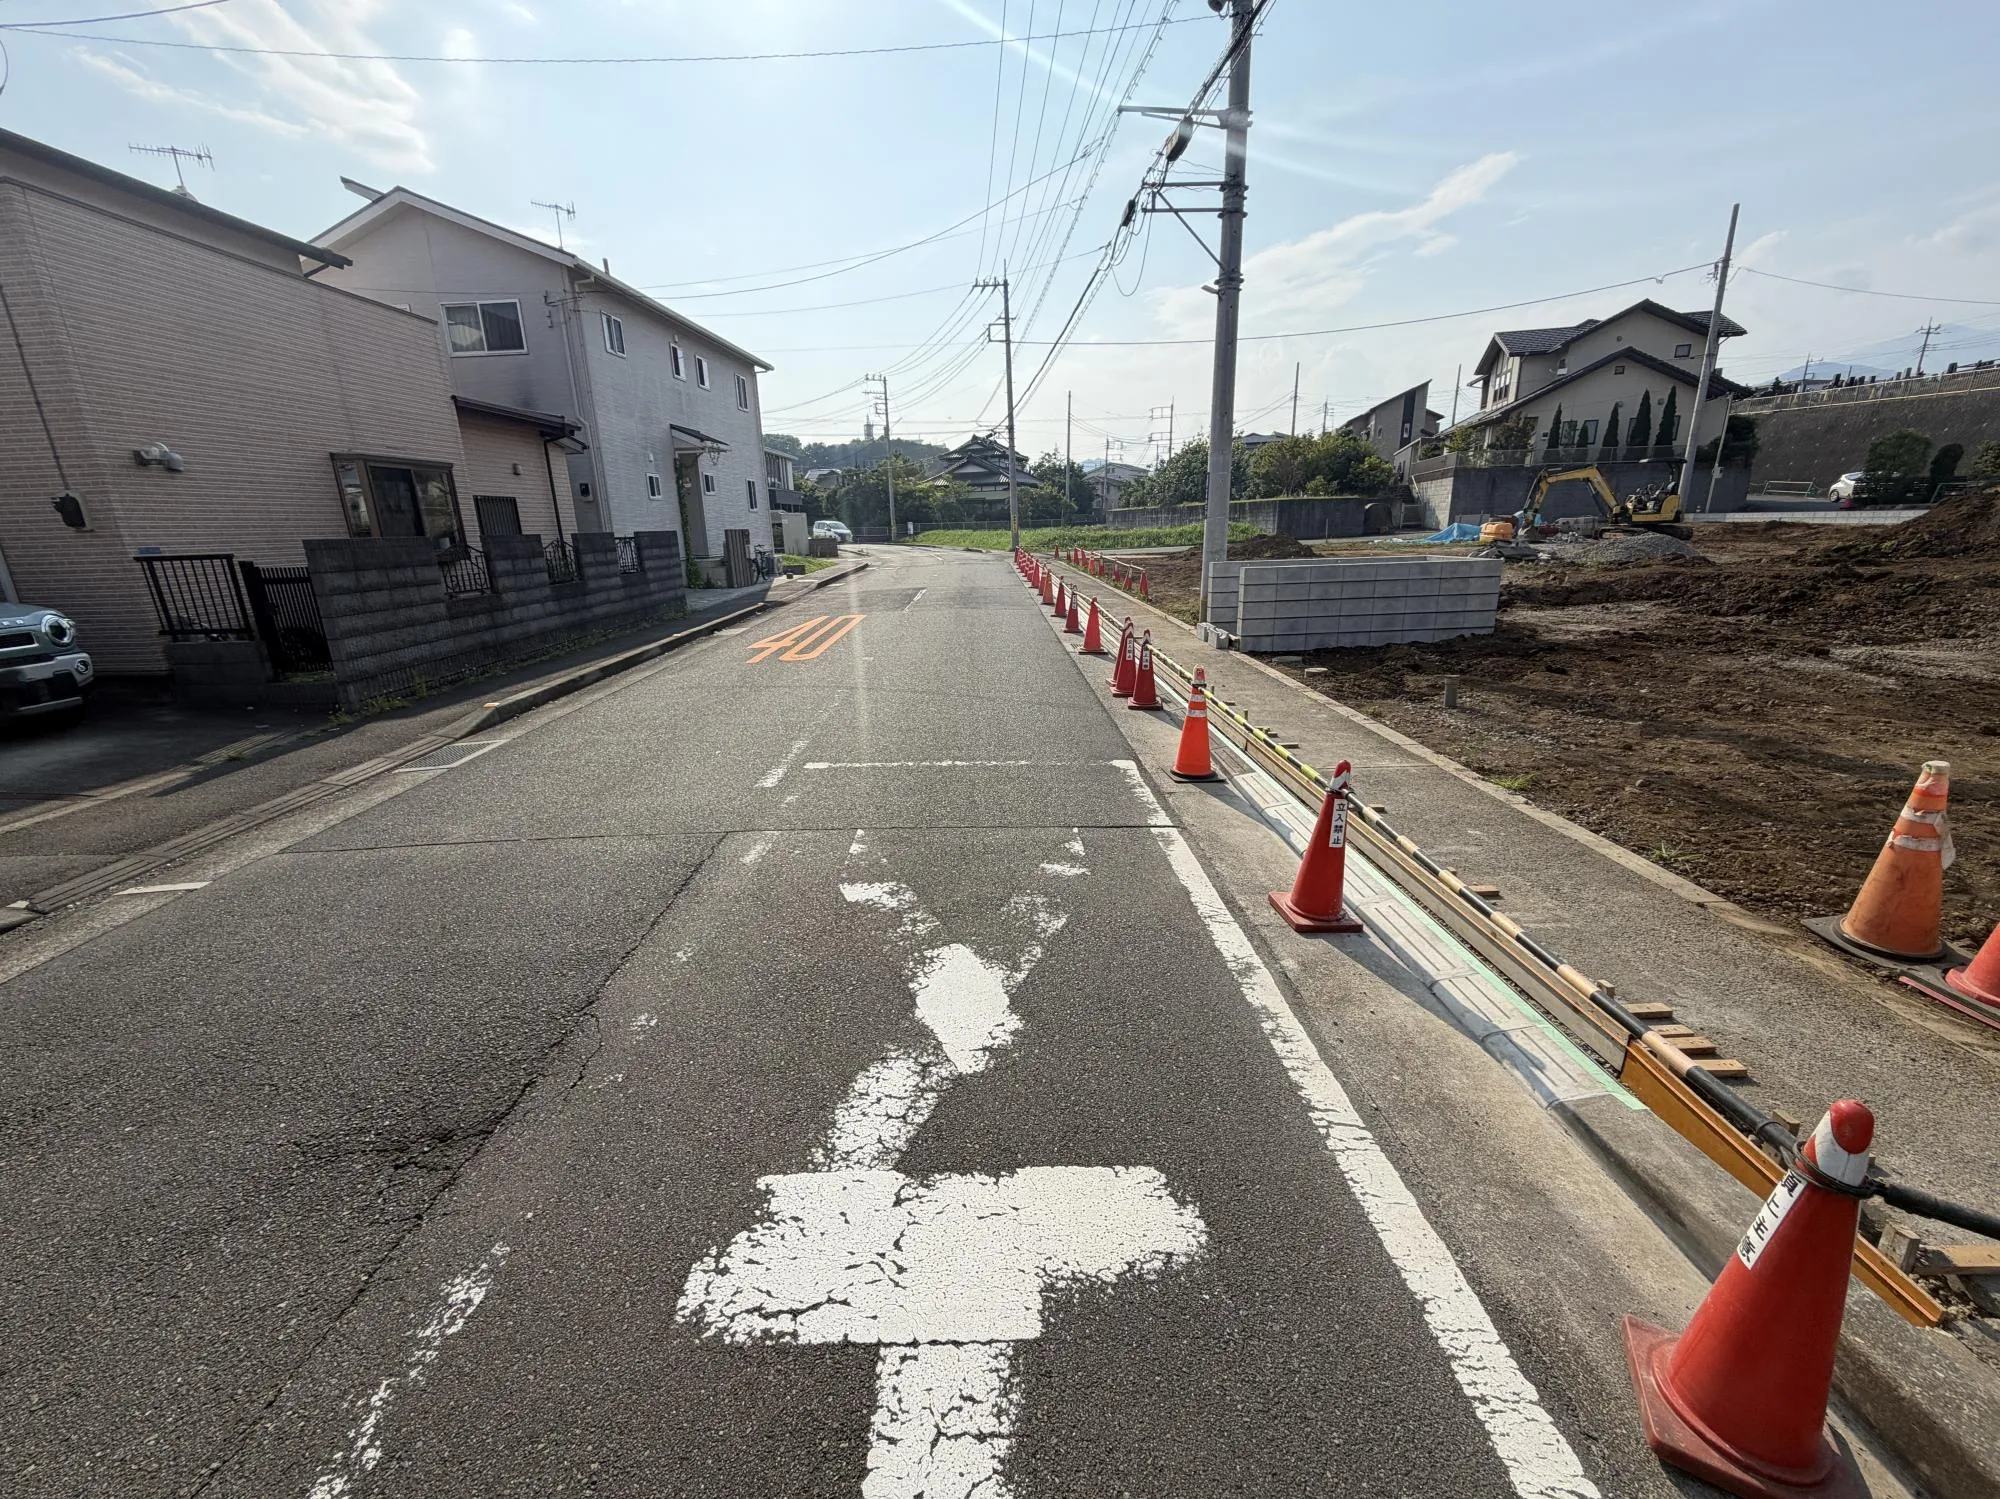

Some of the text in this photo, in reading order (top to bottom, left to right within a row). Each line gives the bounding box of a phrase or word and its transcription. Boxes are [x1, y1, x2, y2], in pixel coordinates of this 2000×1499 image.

[746, 614, 867, 665] 40
[1332, 803, 1346, 845] 立入禁止
